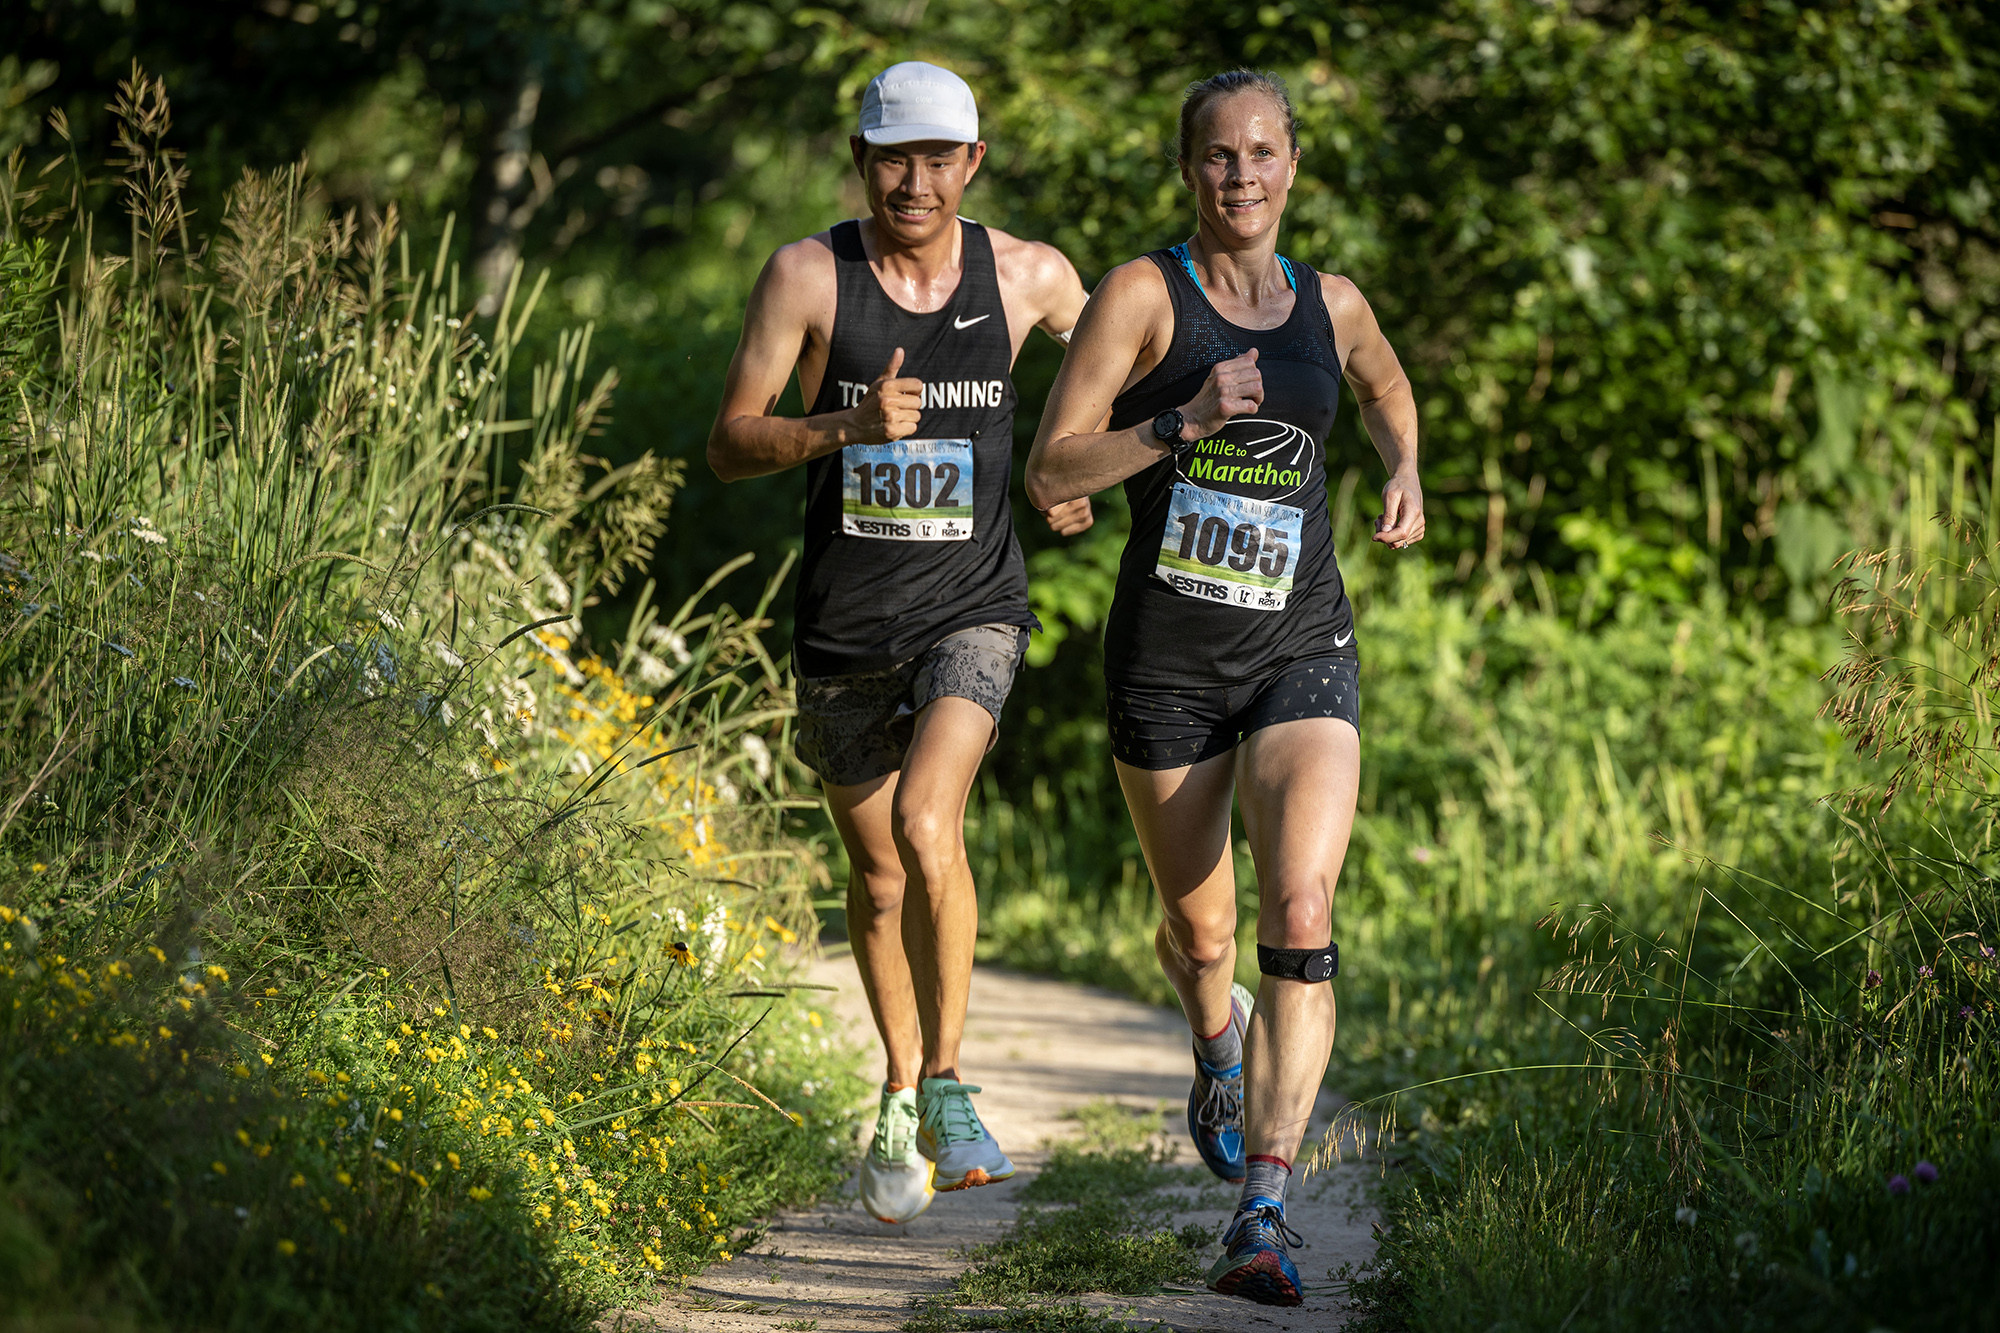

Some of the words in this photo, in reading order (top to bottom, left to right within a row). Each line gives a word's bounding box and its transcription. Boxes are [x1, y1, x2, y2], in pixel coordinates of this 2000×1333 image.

[1195, 439, 1235, 456] Mile
[1235, 448, 1247, 457] to
[853, 462, 960, 509] 1302
[1188, 457, 1301, 487] Marathon
[1184, 489, 1208, 504] ENDLESS
[1251, 503, 1262, 515] RUN
[1177, 512, 1289, 578] 1095
